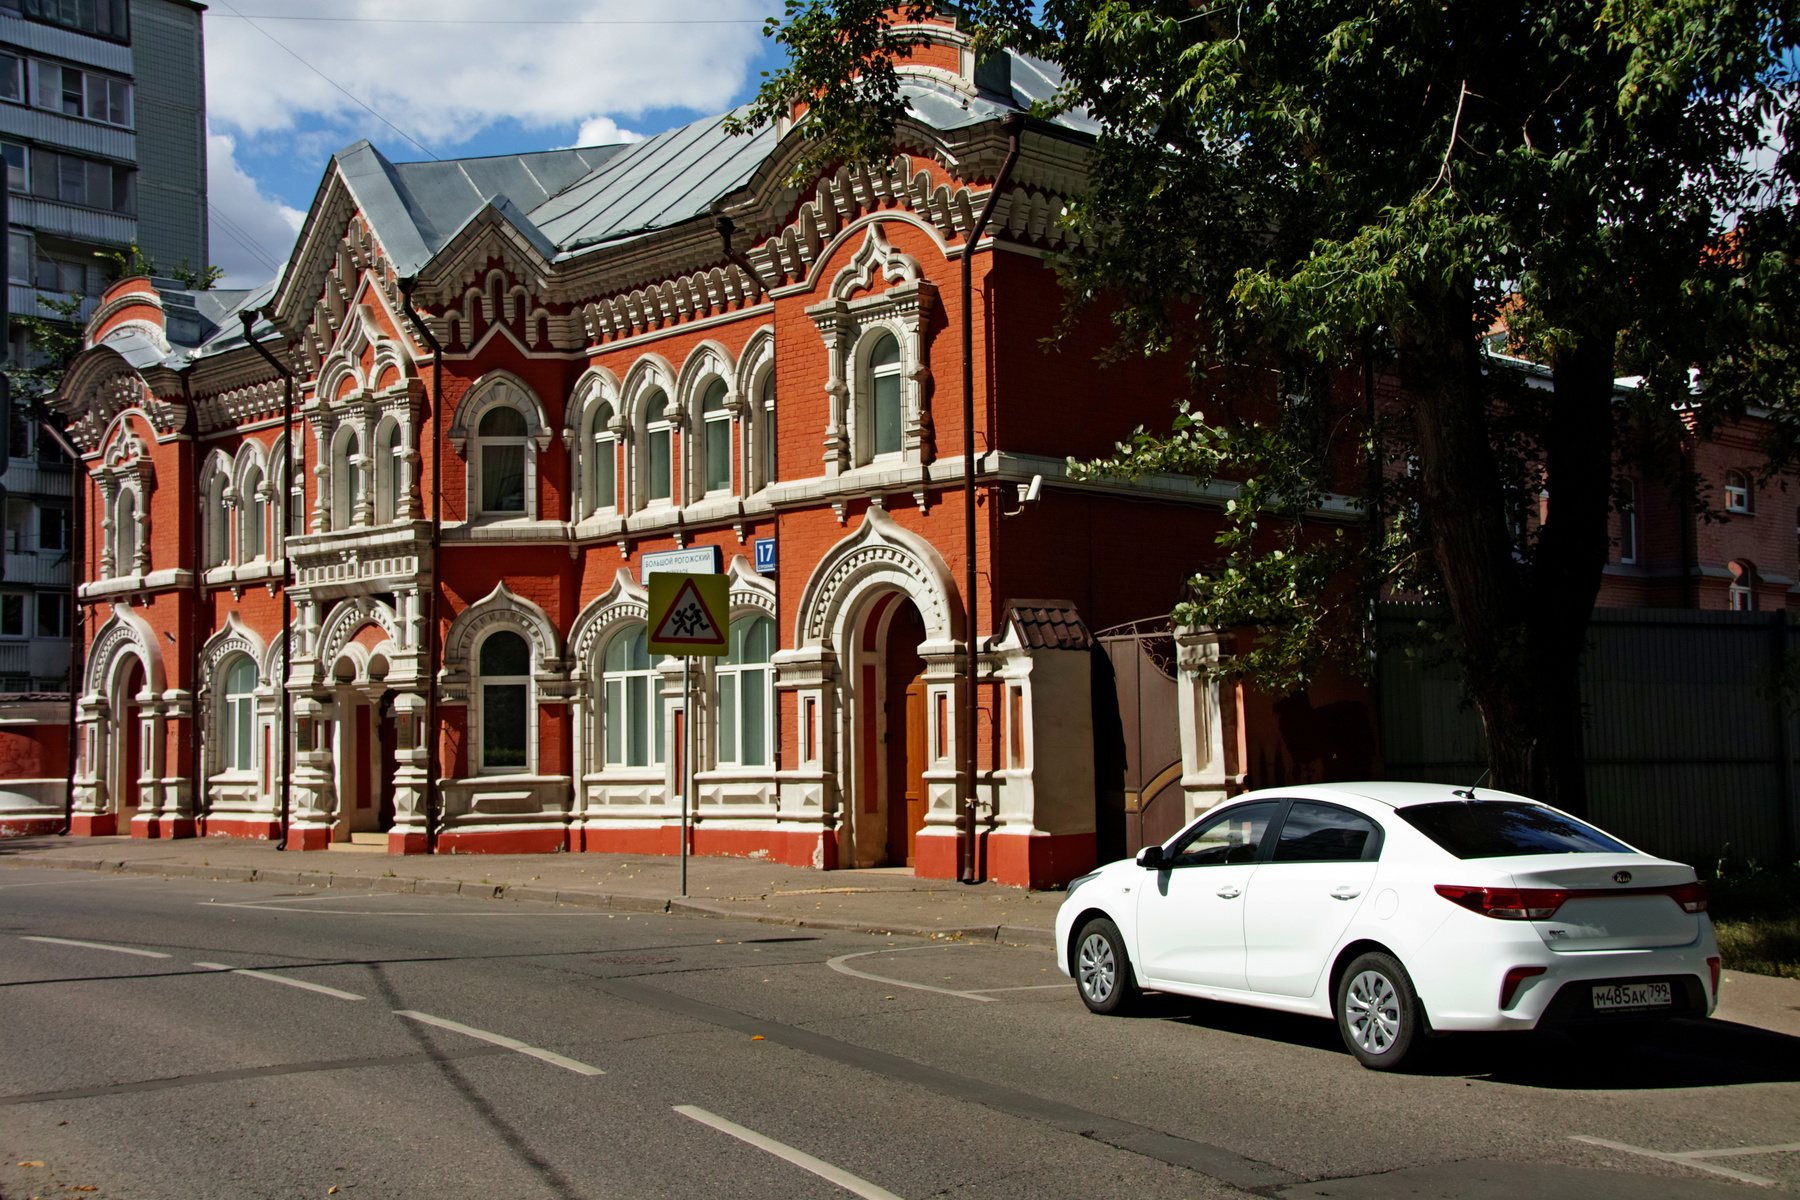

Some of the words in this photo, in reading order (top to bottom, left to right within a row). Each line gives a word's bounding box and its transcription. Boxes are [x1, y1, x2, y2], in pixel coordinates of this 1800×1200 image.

[758, 544, 773, 562] 17
[645, 557, 673, 568] БОЛЬШОЙ
[674, 553, 710, 564] РОГОЖСКИЙ
[1617, 873, 1631, 883] KIA
[1648, 984, 1667, 998] 799
